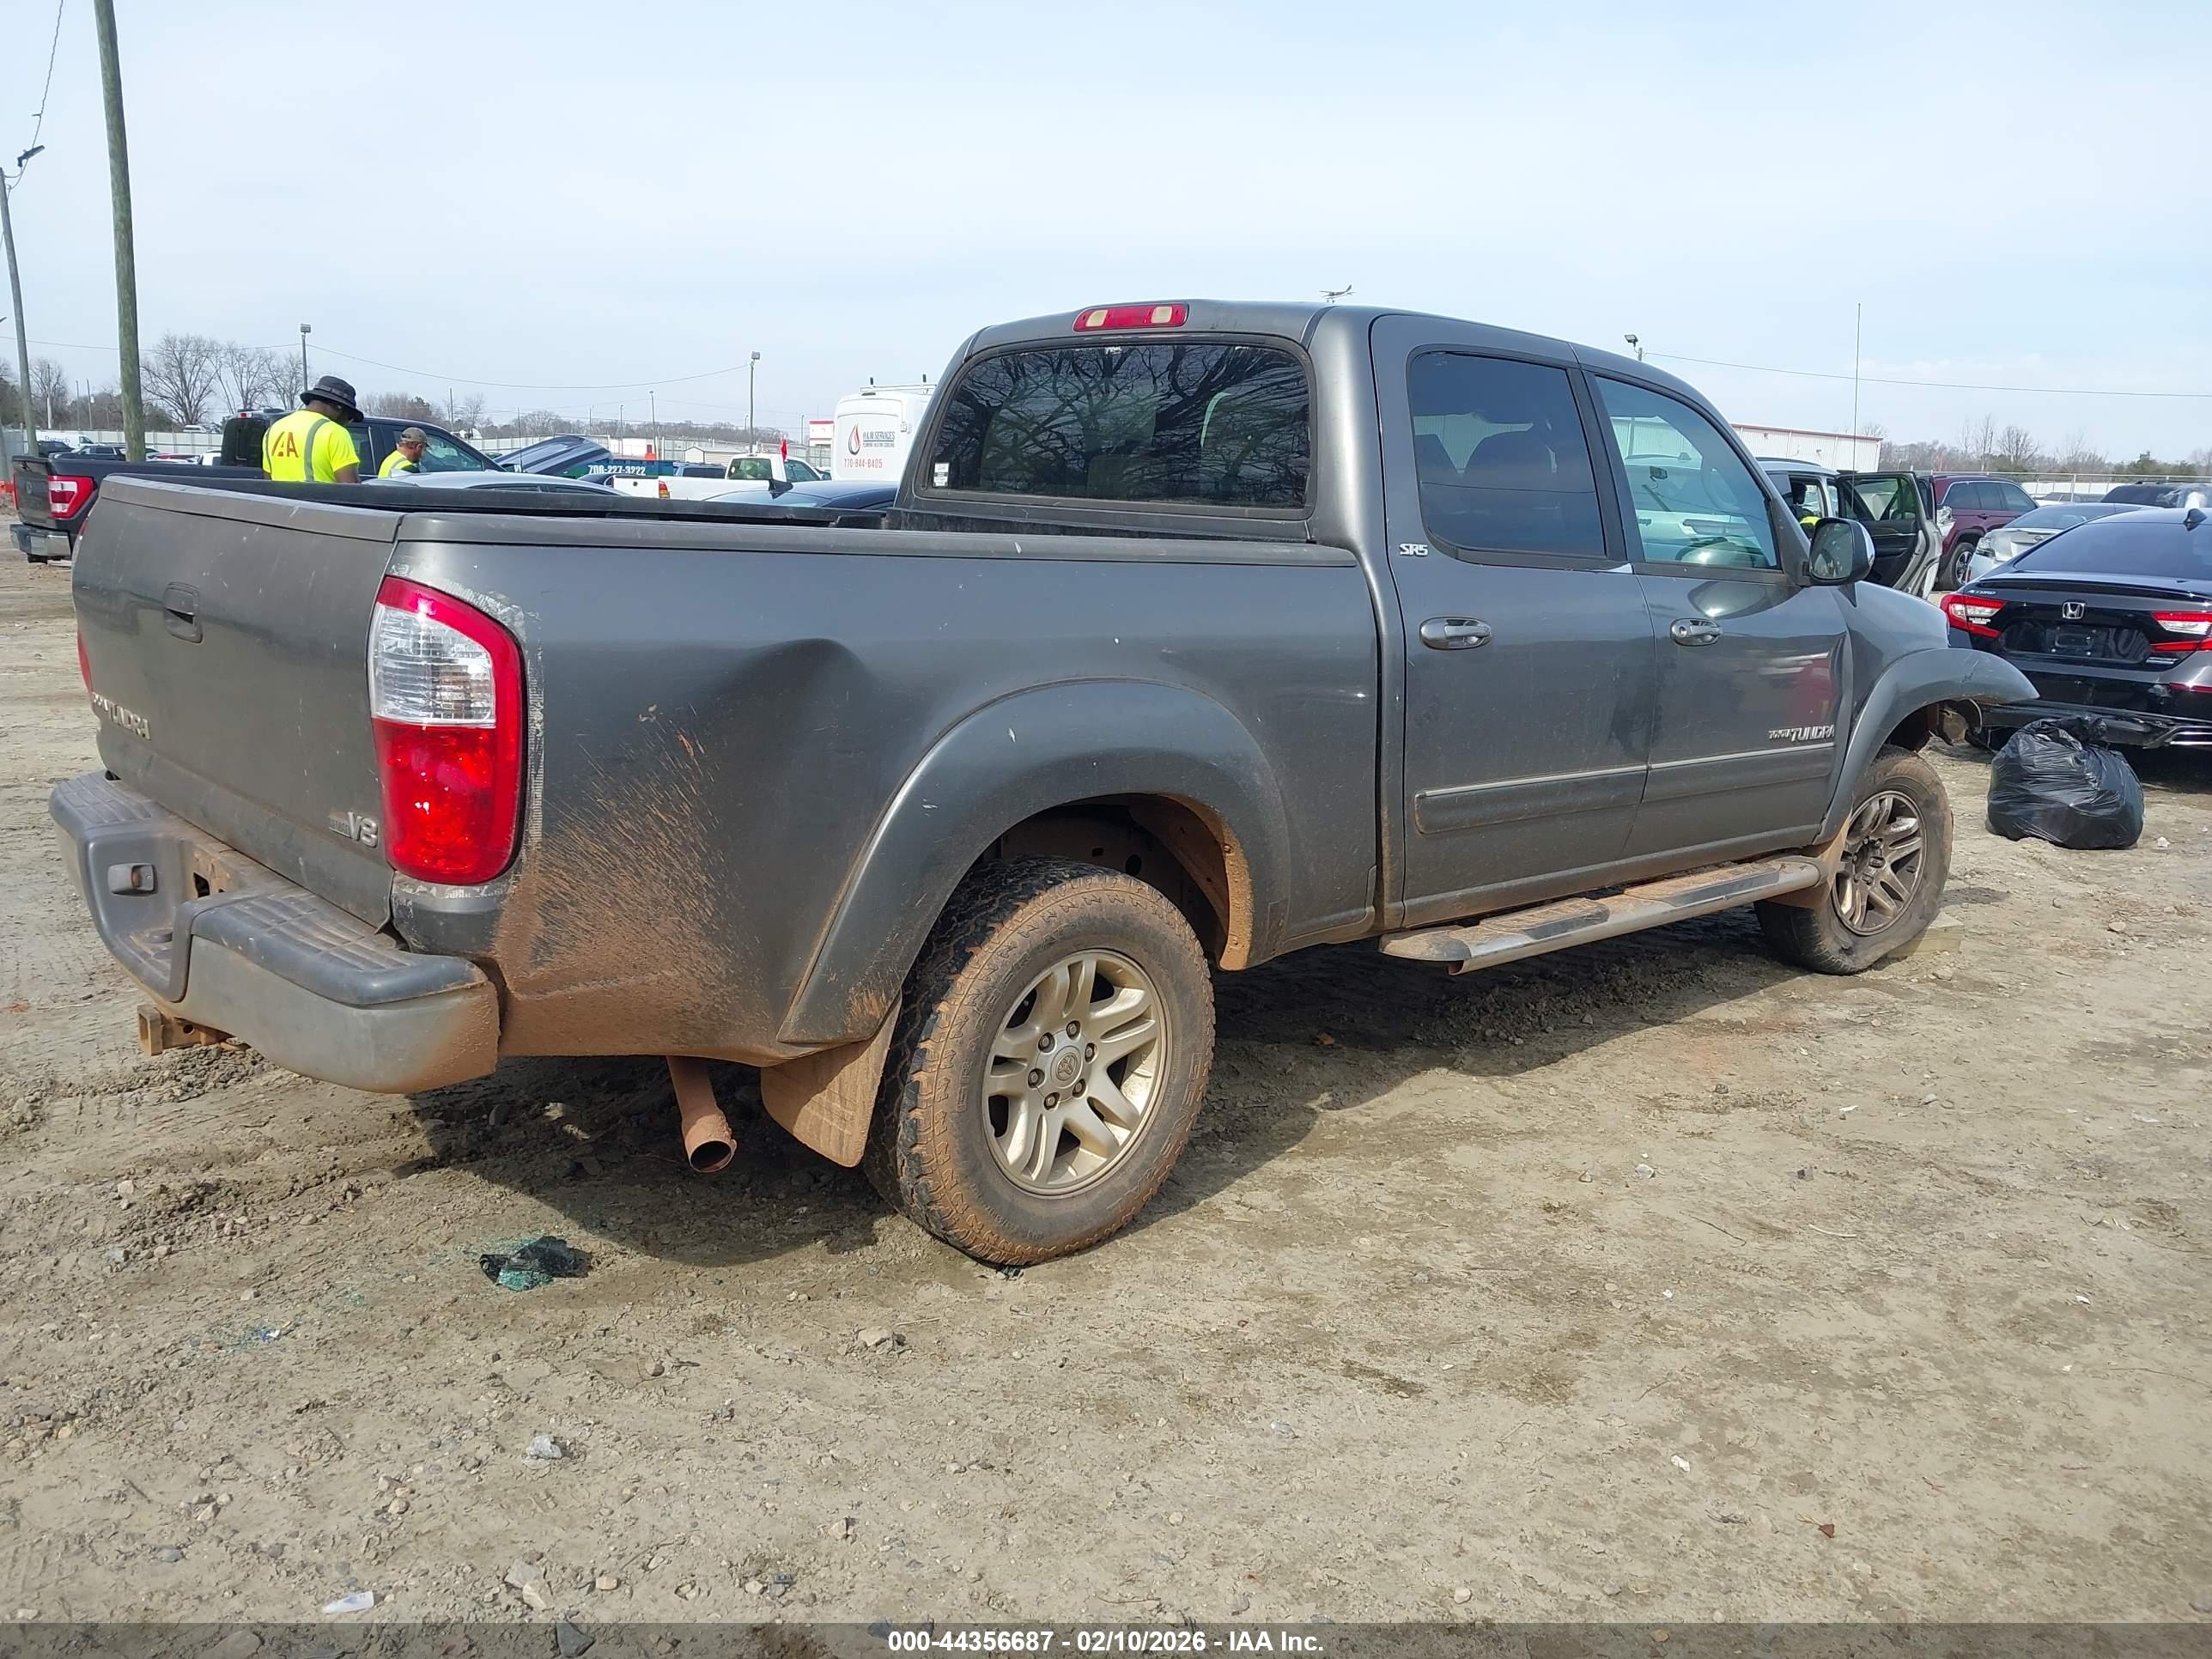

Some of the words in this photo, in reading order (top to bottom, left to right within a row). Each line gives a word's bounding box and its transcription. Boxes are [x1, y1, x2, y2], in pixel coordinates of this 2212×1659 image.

[1399, 543, 1428, 556] SR5
[1790, 724, 1835, 742] TUNDRA
[347, 811, 379, 848] V8
